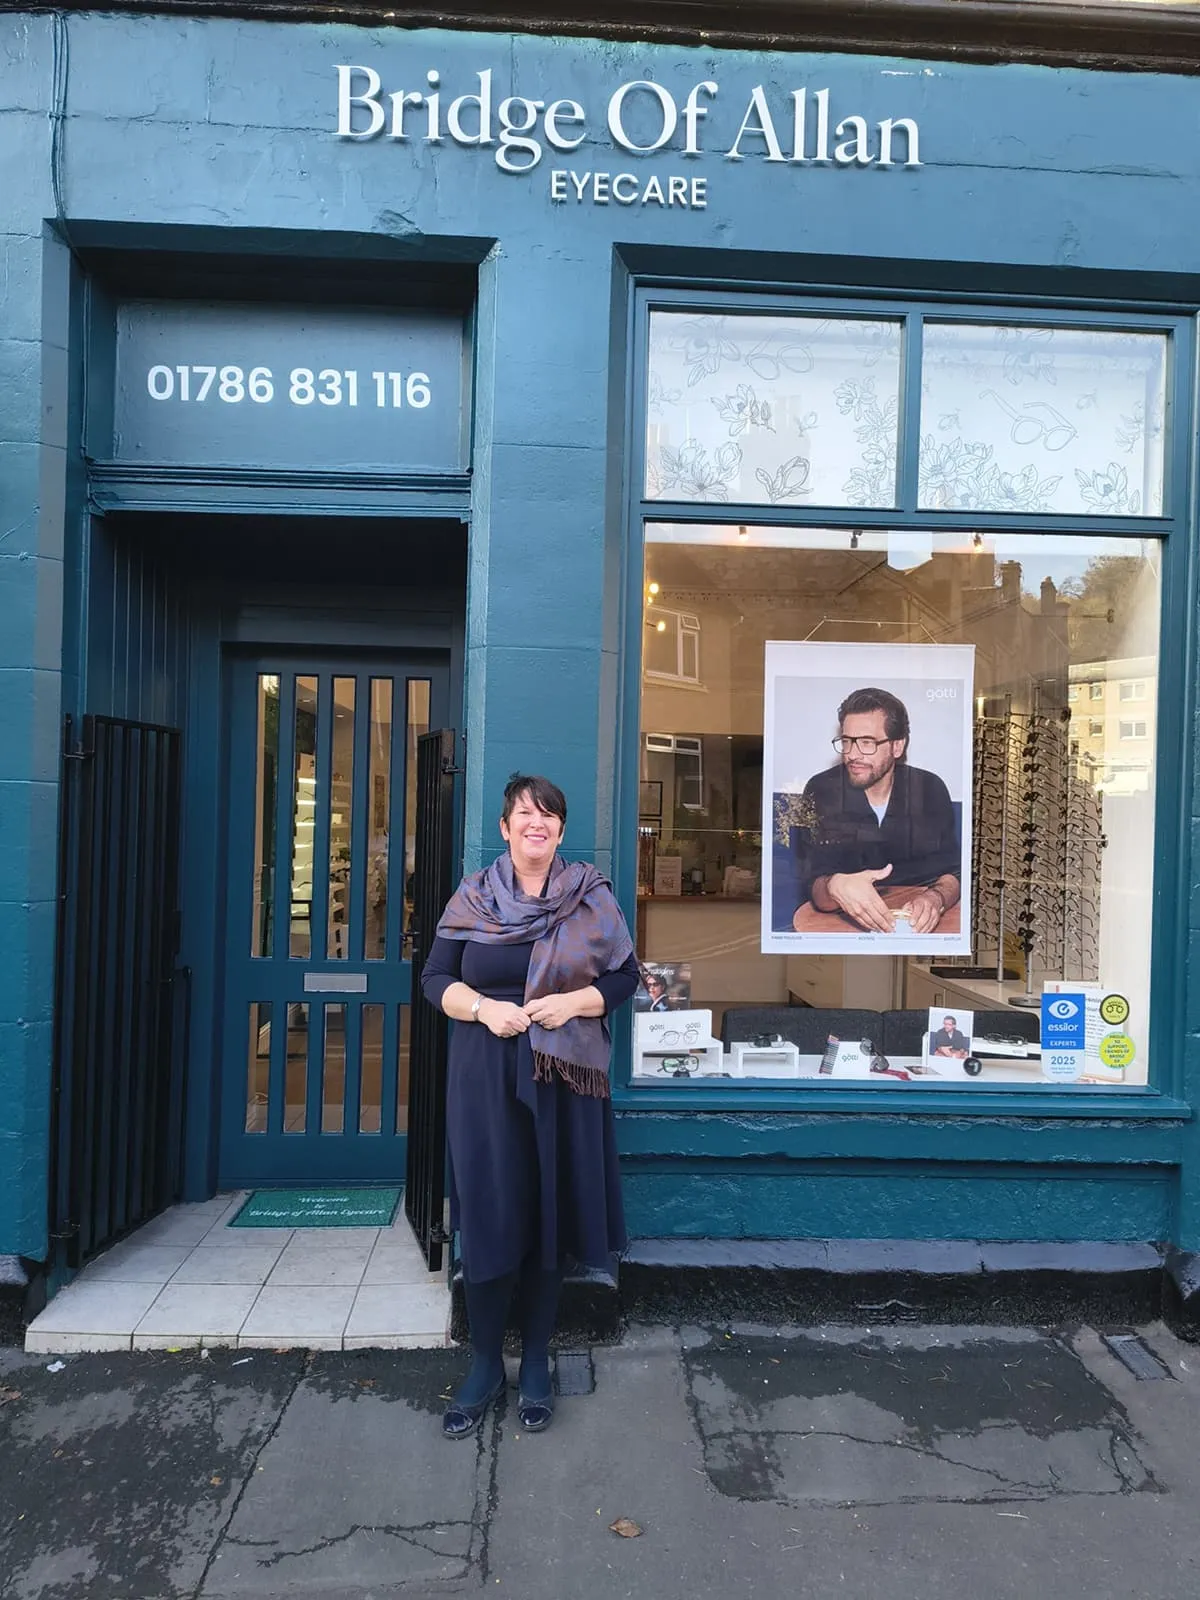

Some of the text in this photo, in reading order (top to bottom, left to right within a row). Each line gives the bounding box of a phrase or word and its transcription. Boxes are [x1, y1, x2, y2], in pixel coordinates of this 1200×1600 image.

[331, 64, 924, 174] Bridge Of Allan
[550, 169, 709, 209] EYECARE
[147, 365, 432, 409] 01786 831 116
[1047, 1022, 1079, 1032] essilor
[1050, 1056, 1076, 1065] 2025
[250, 1209, 290, 1217] Bridge
[291, 1209, 304, 1218] of
[340, 1209, 386, 1217] Eyecare
